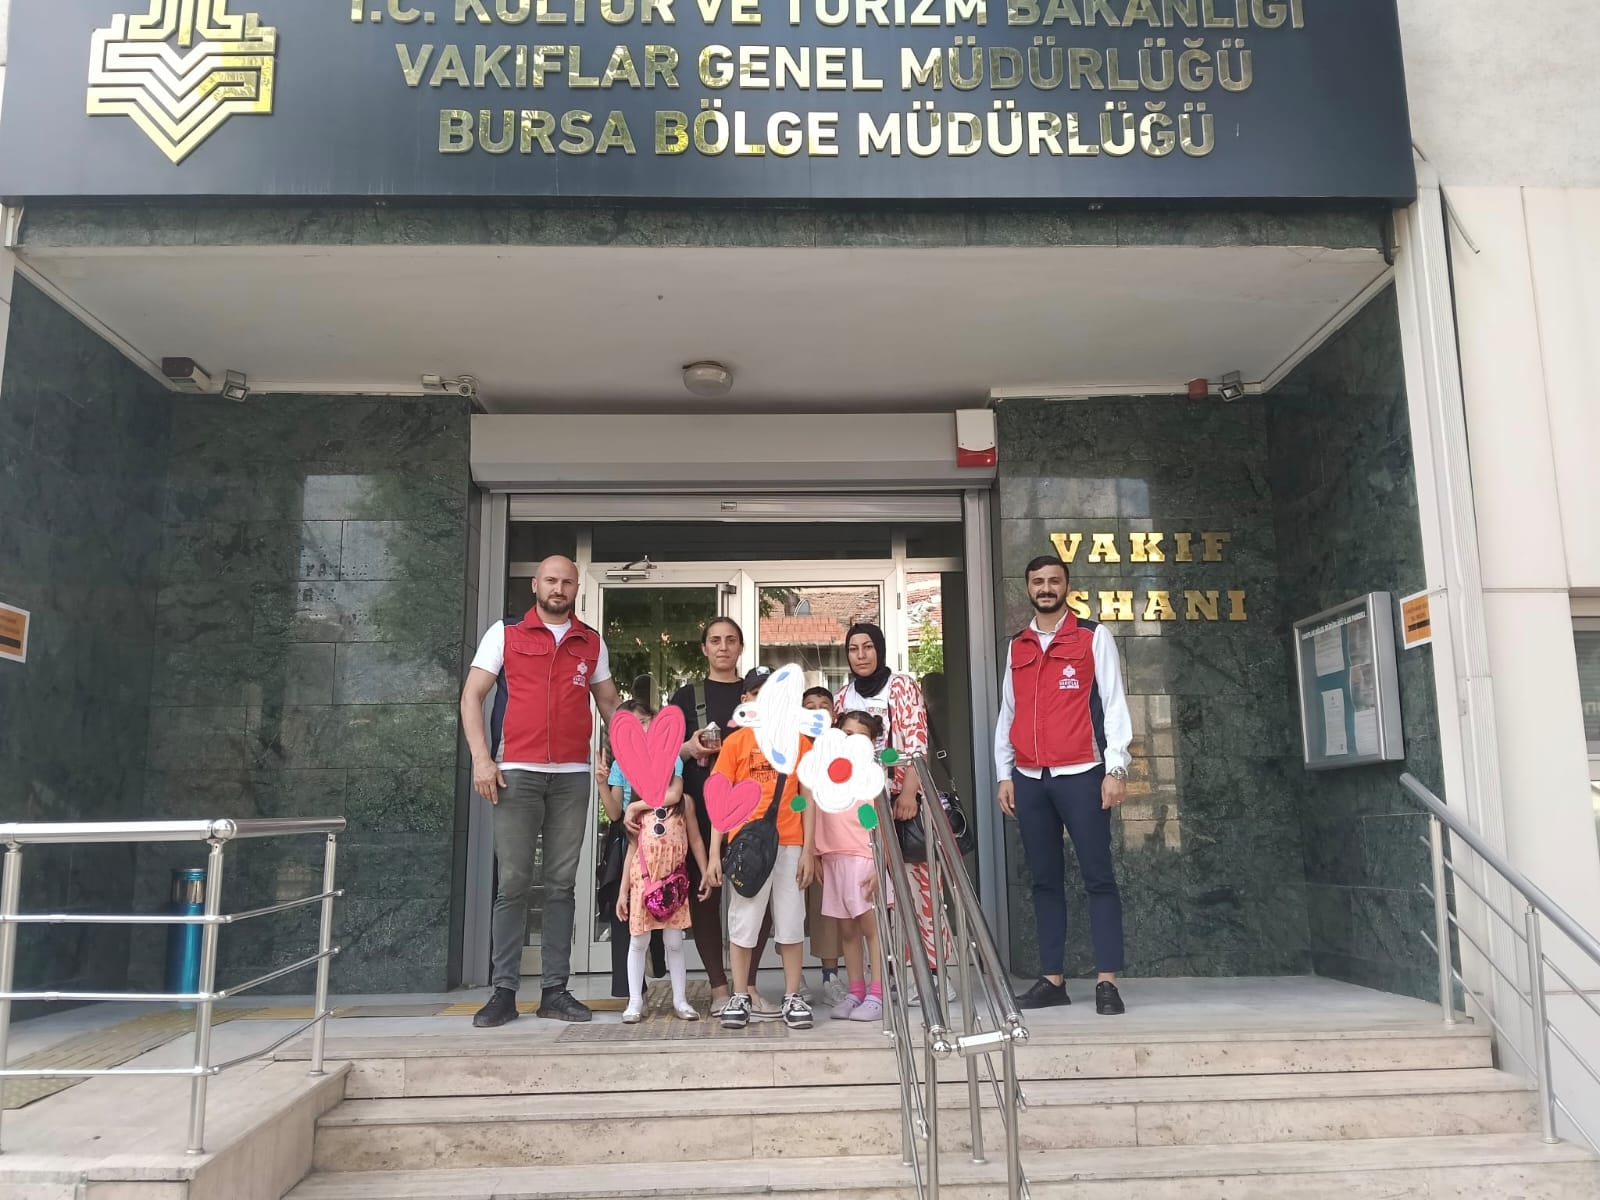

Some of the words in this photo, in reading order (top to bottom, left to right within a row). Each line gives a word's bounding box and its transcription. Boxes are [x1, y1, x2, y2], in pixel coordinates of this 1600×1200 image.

[696, 0, 762, 25] VE
[395, 44, 679, 88] VAKIFLAR
[697, 46, 883, 91] GENEL
[901, 36, 1253, 93] MÜDÜRLÜĞÜ
[439, 109, 637, 155] BURSA
[655, 98, 840, 158] BÖLGE
[858, 99, 1215, 158] MÜDÜRLÜĞÜ
[1050, 533, 1231, 562] VAKIF
[1066, 590, 1247, 621] SHANI
